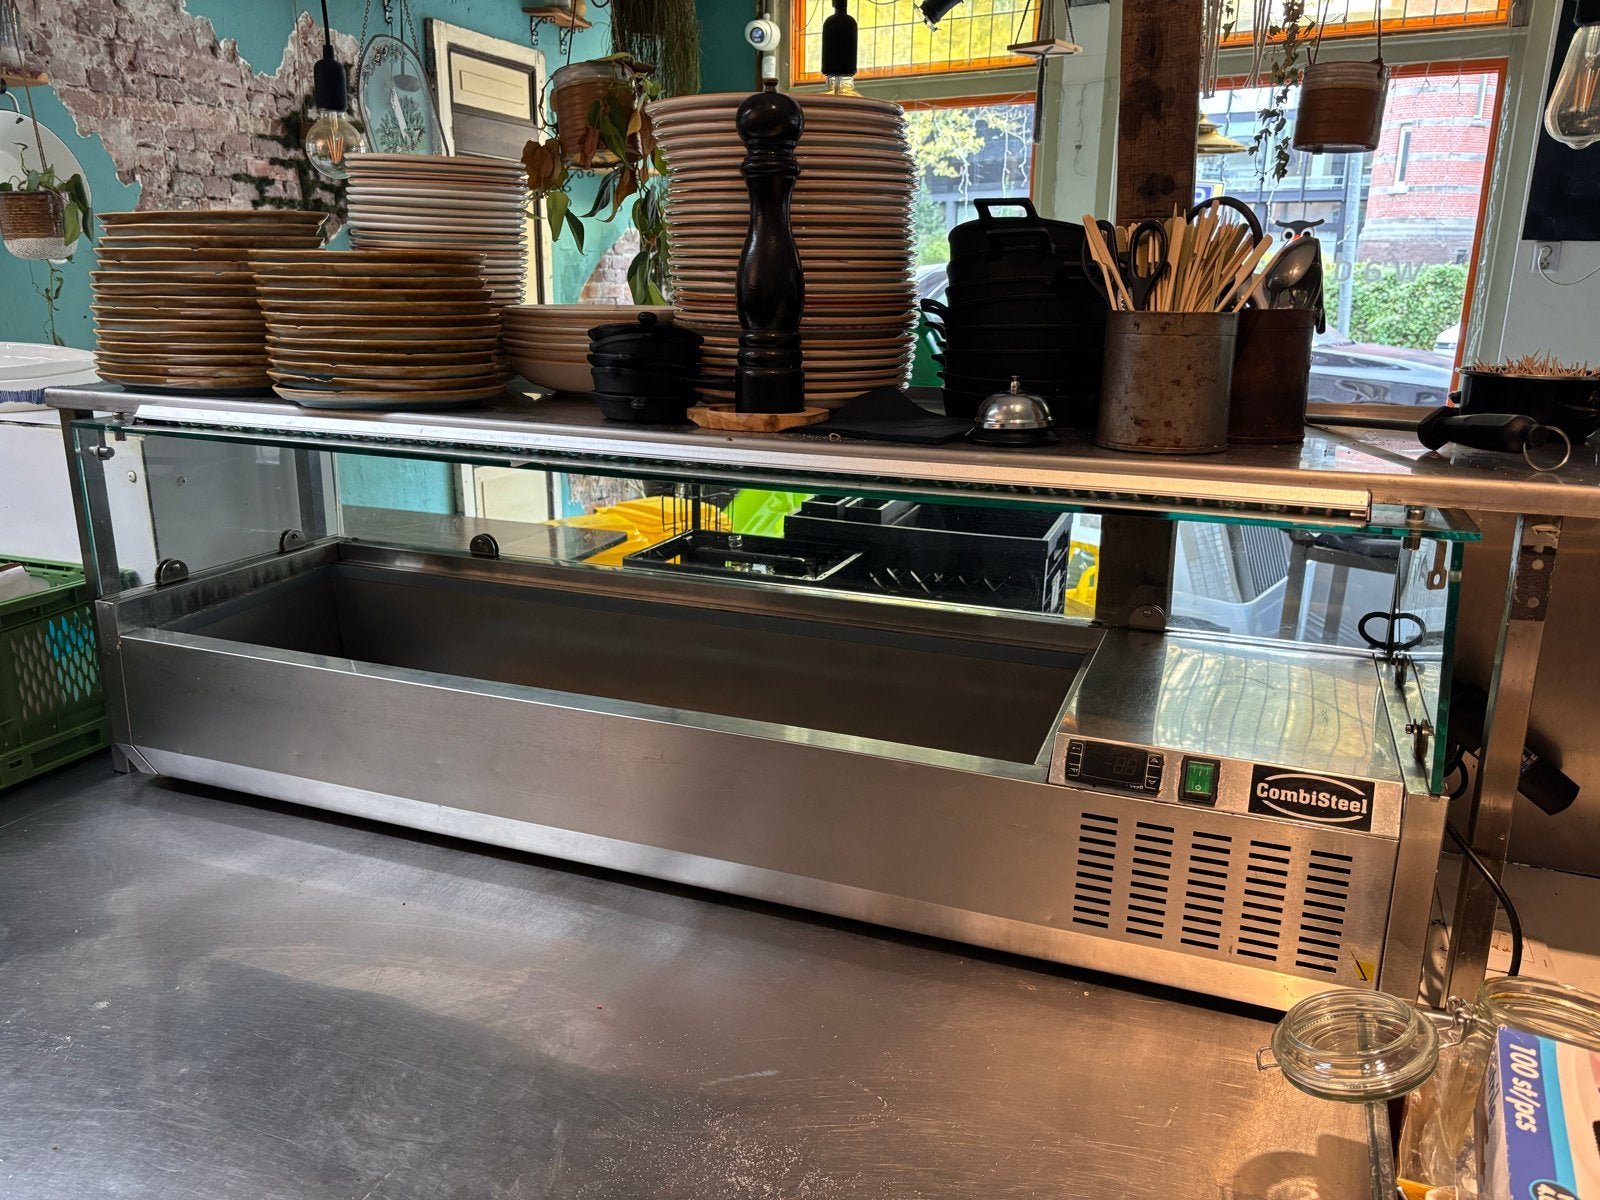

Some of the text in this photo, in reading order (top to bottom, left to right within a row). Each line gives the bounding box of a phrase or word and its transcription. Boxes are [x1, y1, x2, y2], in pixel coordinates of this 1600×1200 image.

[1256, 782, 1368, 814] CombiSteel
[1505, 1043, 1541, 1133] 100 st/pcs
